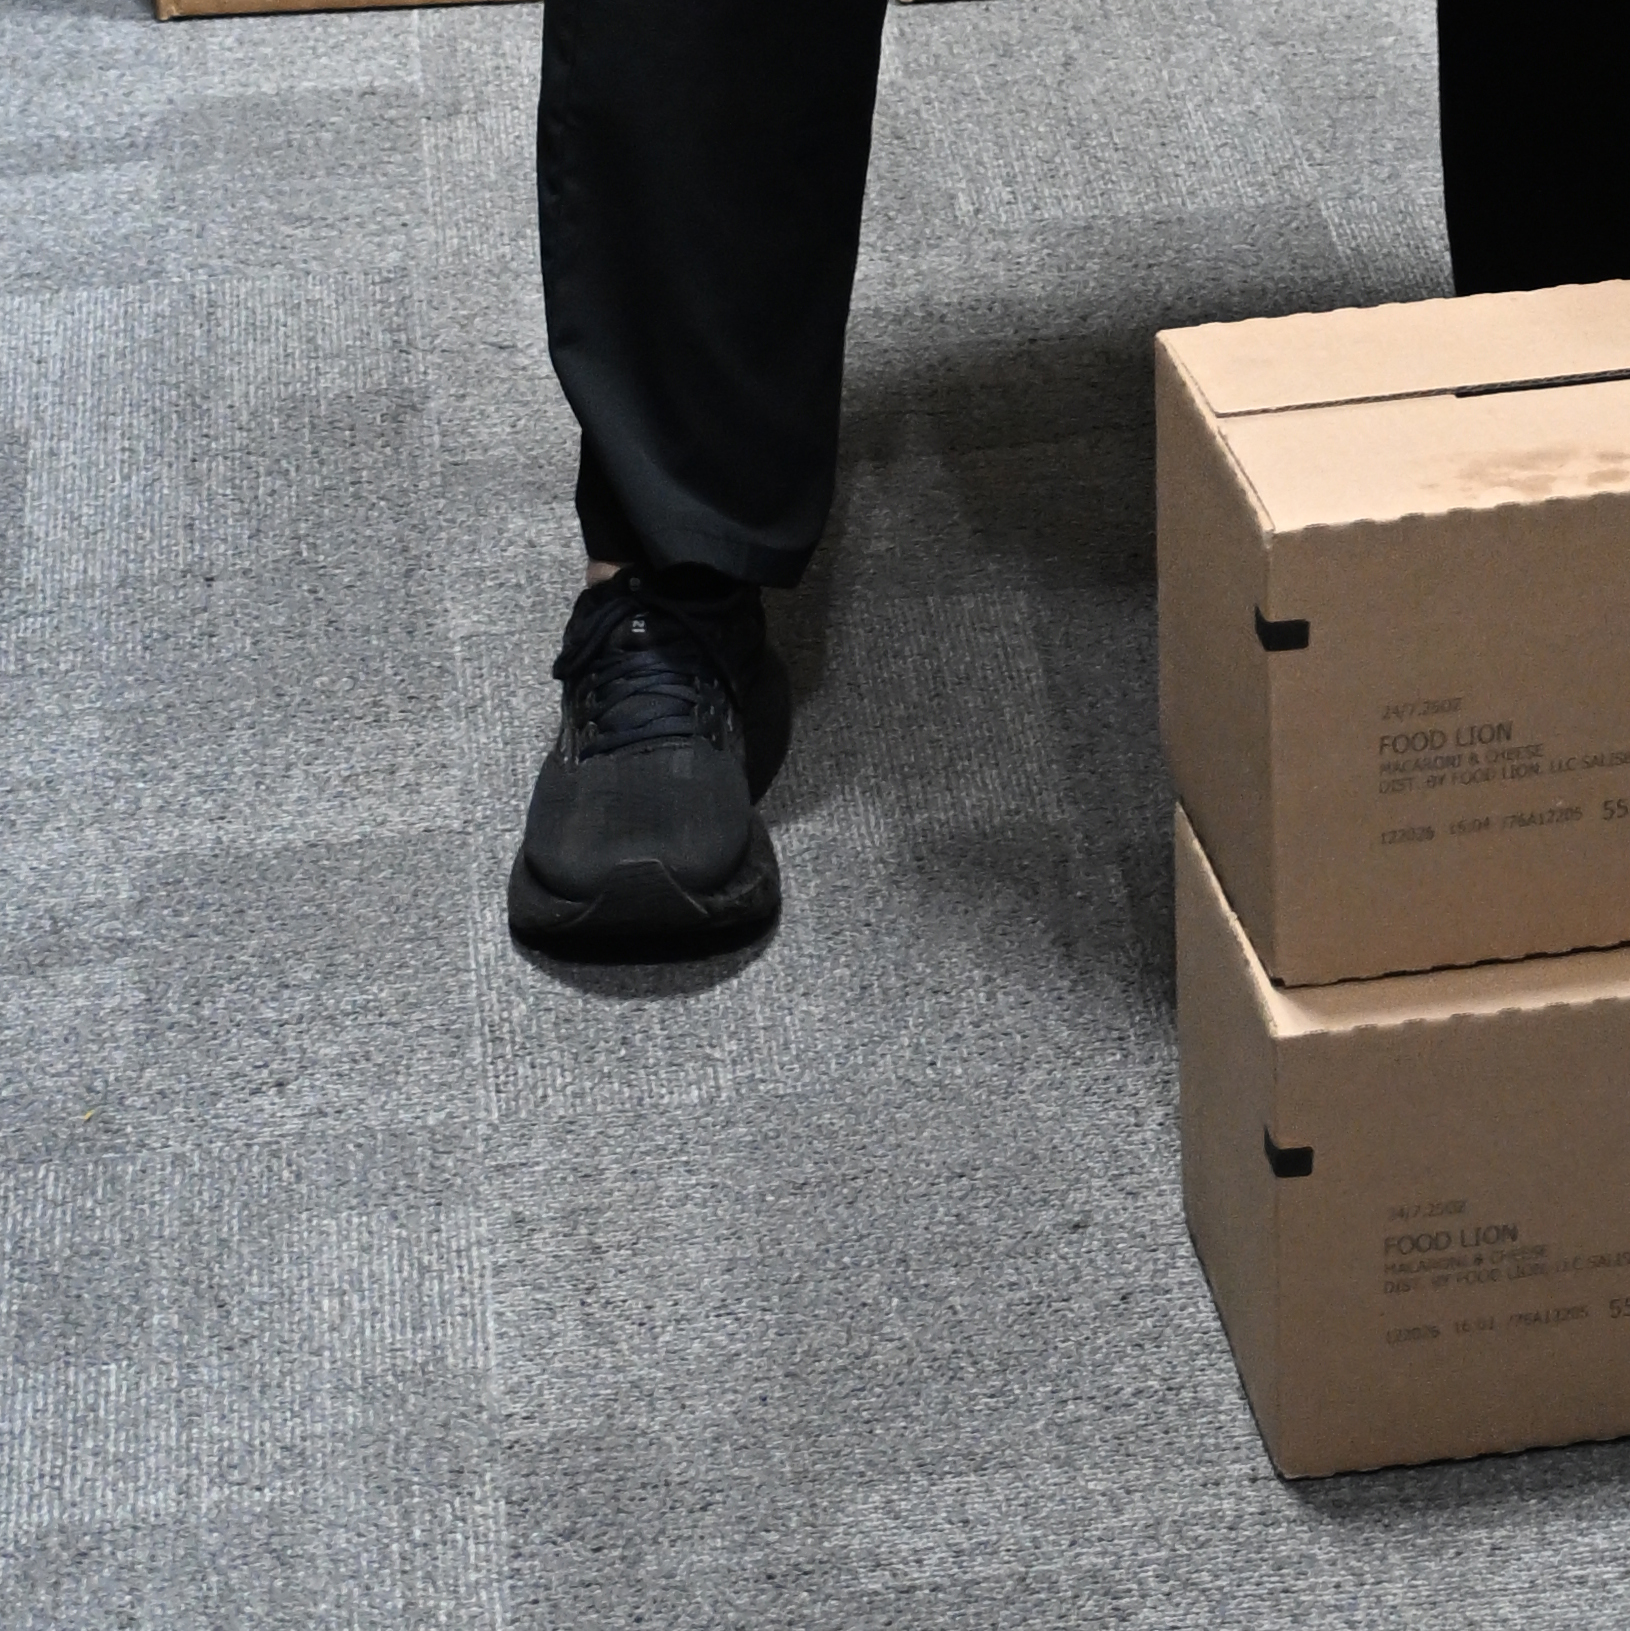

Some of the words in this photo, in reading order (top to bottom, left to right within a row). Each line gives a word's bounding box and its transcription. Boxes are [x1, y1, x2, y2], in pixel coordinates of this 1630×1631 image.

[1379, 727, 1447, 755] FOOD
[1455, 721, 1514, 748] LION
[1384, 1229, 1452, 1256] FOOD
[1460, 1223, 1519, 1248] LION
